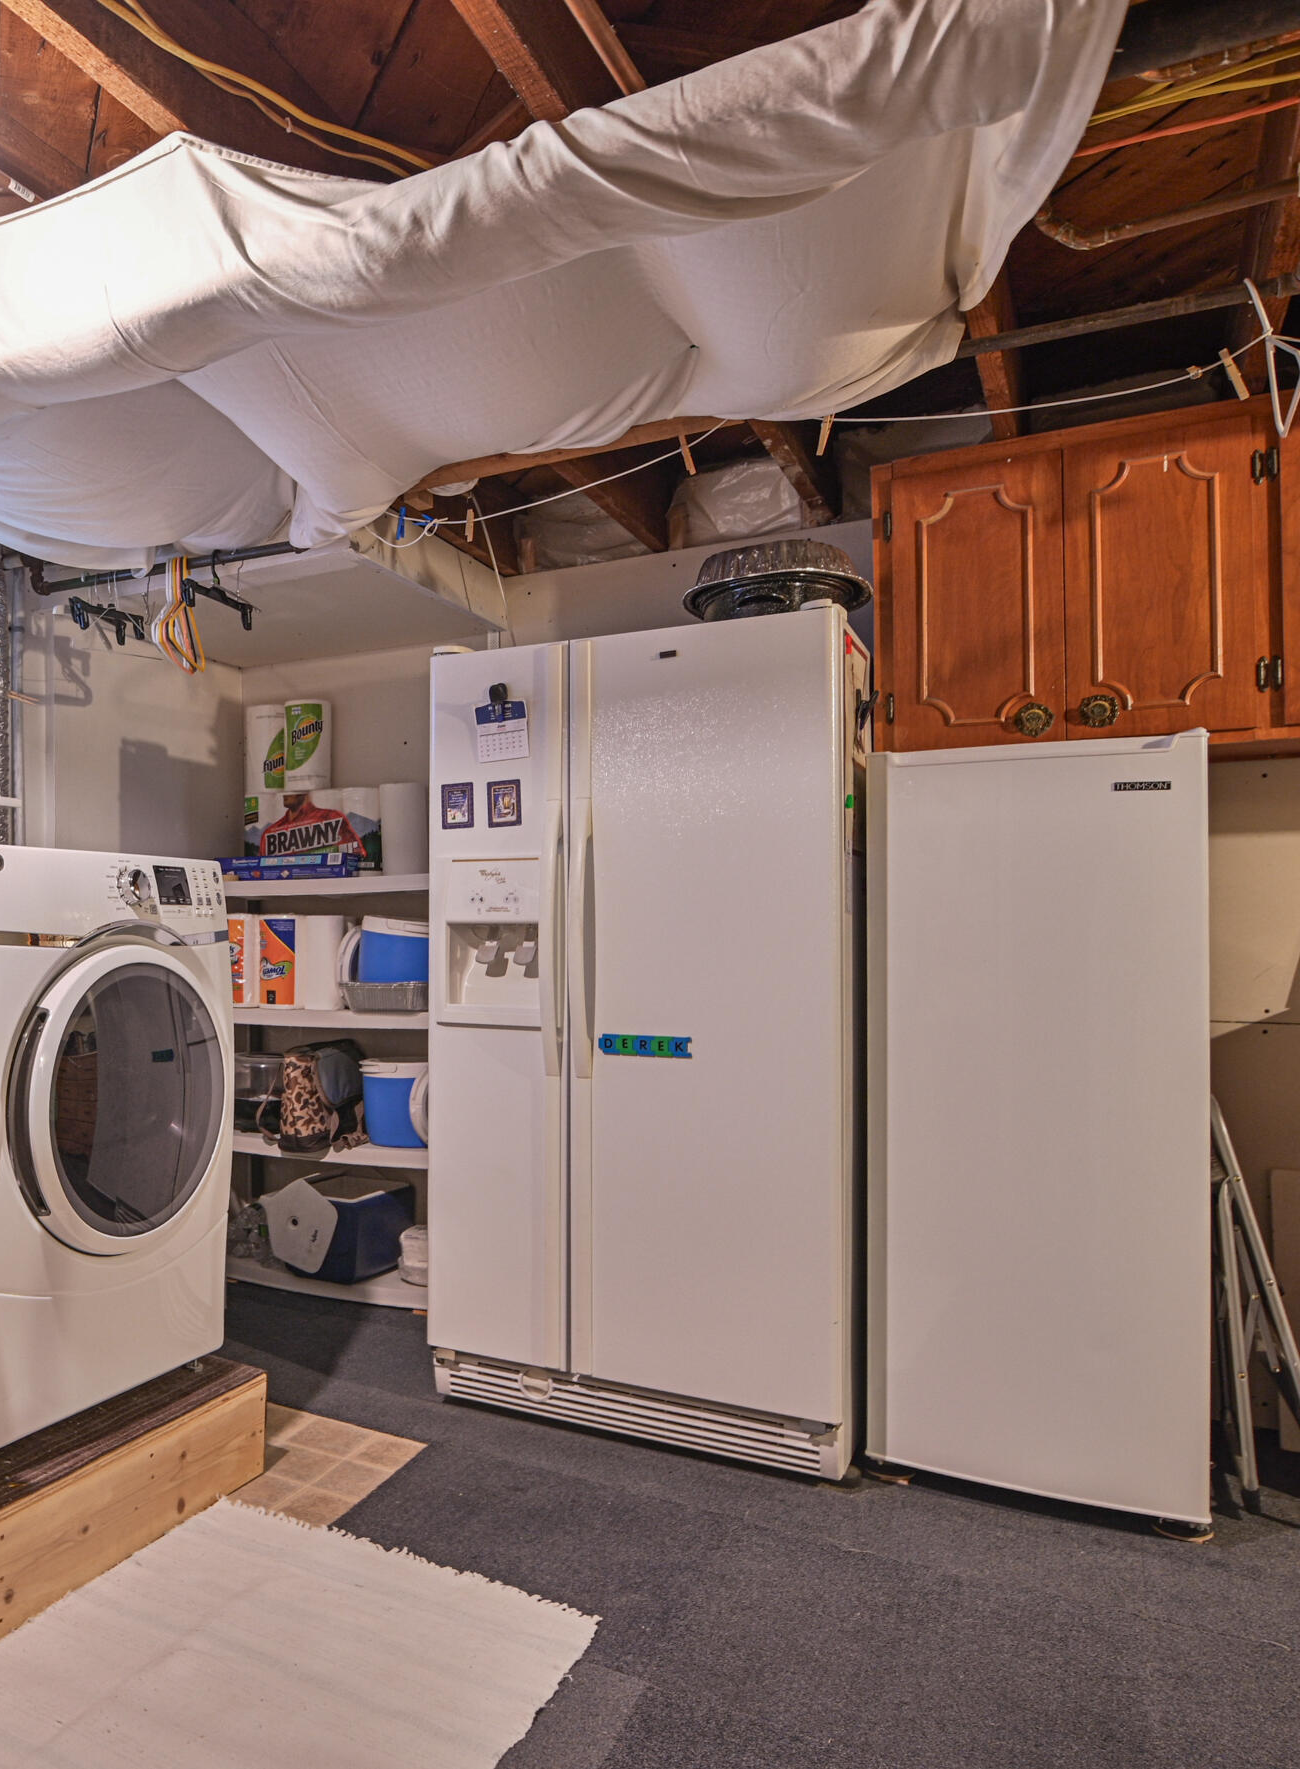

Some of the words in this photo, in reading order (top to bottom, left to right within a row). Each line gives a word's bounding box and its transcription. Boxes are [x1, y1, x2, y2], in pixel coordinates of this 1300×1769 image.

[291, 719, 324, 746] Bounty
[262, 755, 284, 773] unty
[1116, 782, 1168, 790] THOMSON
[266, 818, 342, 856] BRAWNY
[604, 1038, 684, 1053] DEREK
